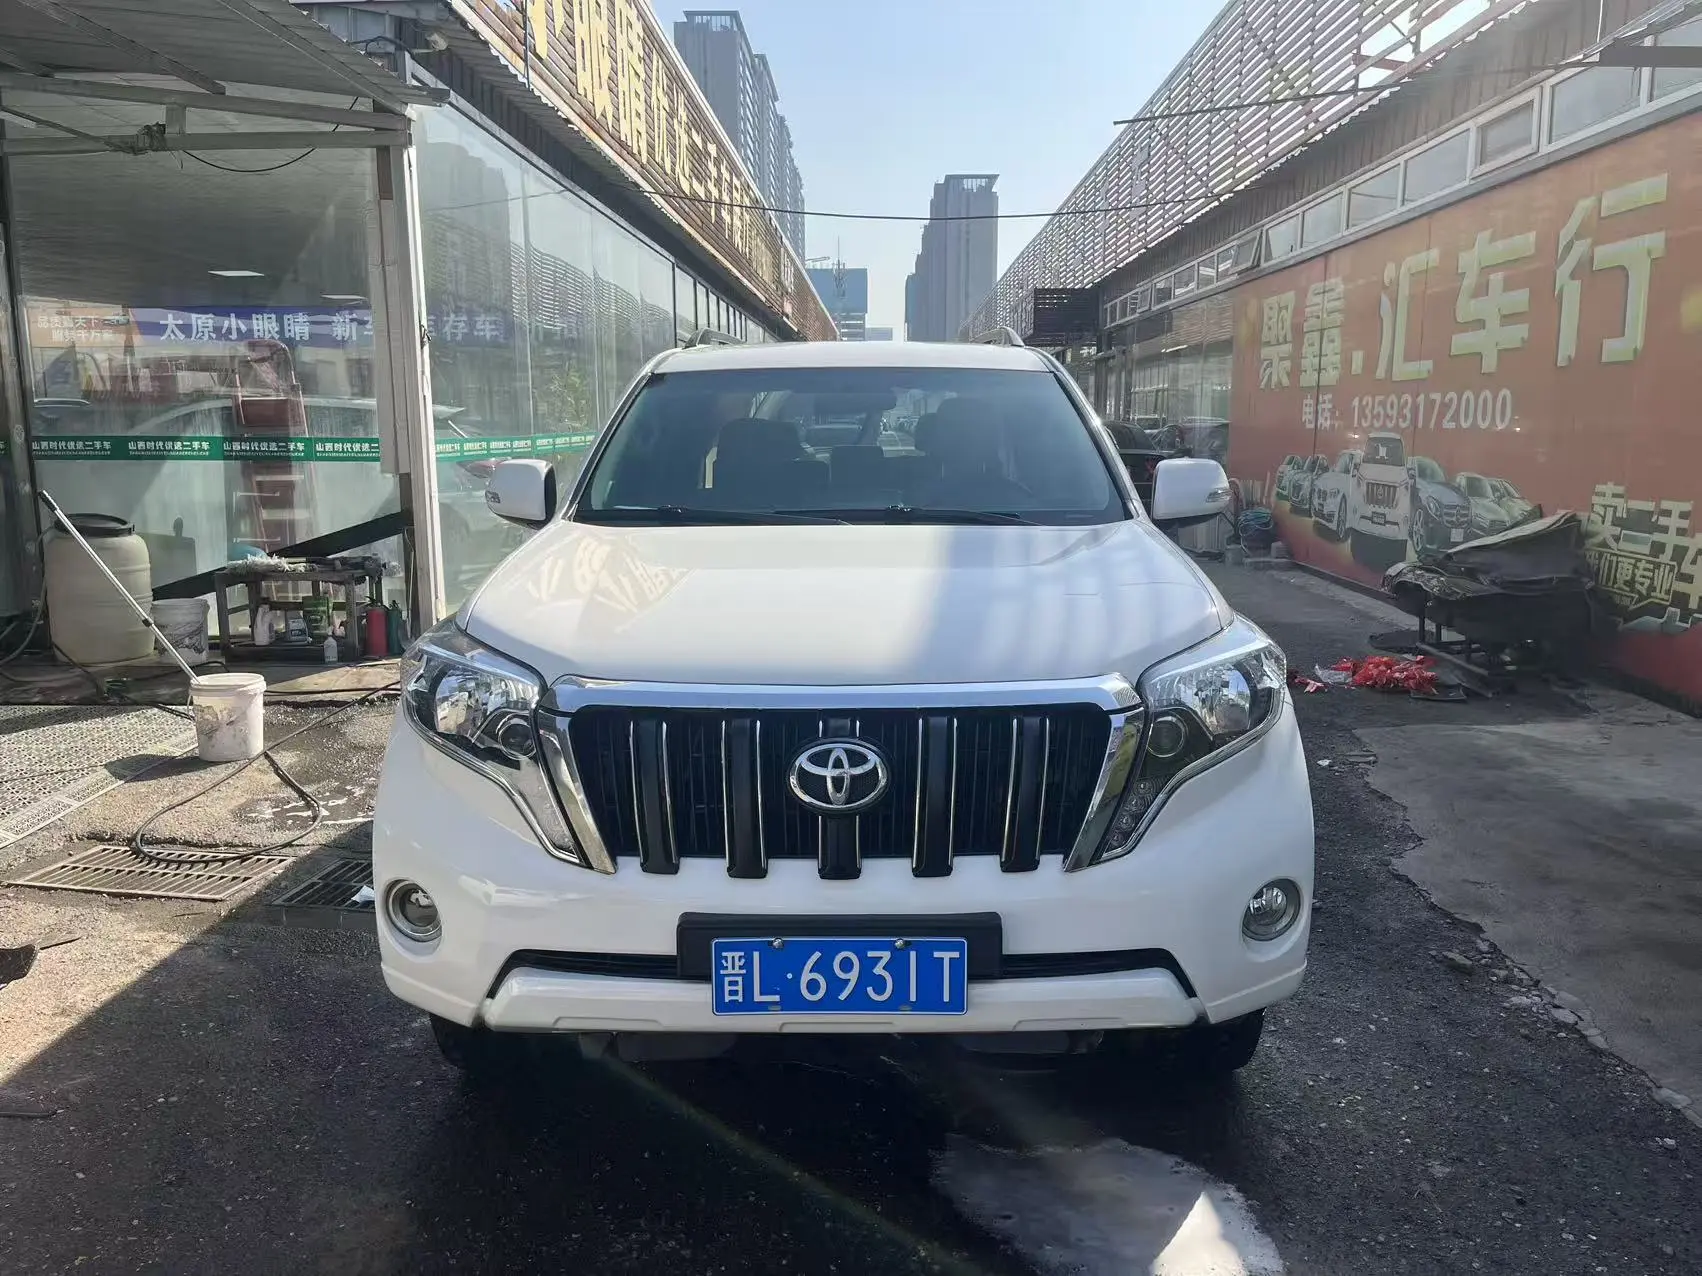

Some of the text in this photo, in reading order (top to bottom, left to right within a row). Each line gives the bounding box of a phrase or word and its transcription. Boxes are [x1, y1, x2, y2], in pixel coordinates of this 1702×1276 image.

[160, 312, 310, 341] 太原小眼睛
[1351, 387, 1513, 431] 13593172000
[719, 950, 961, 1003] 晋L·6931T
